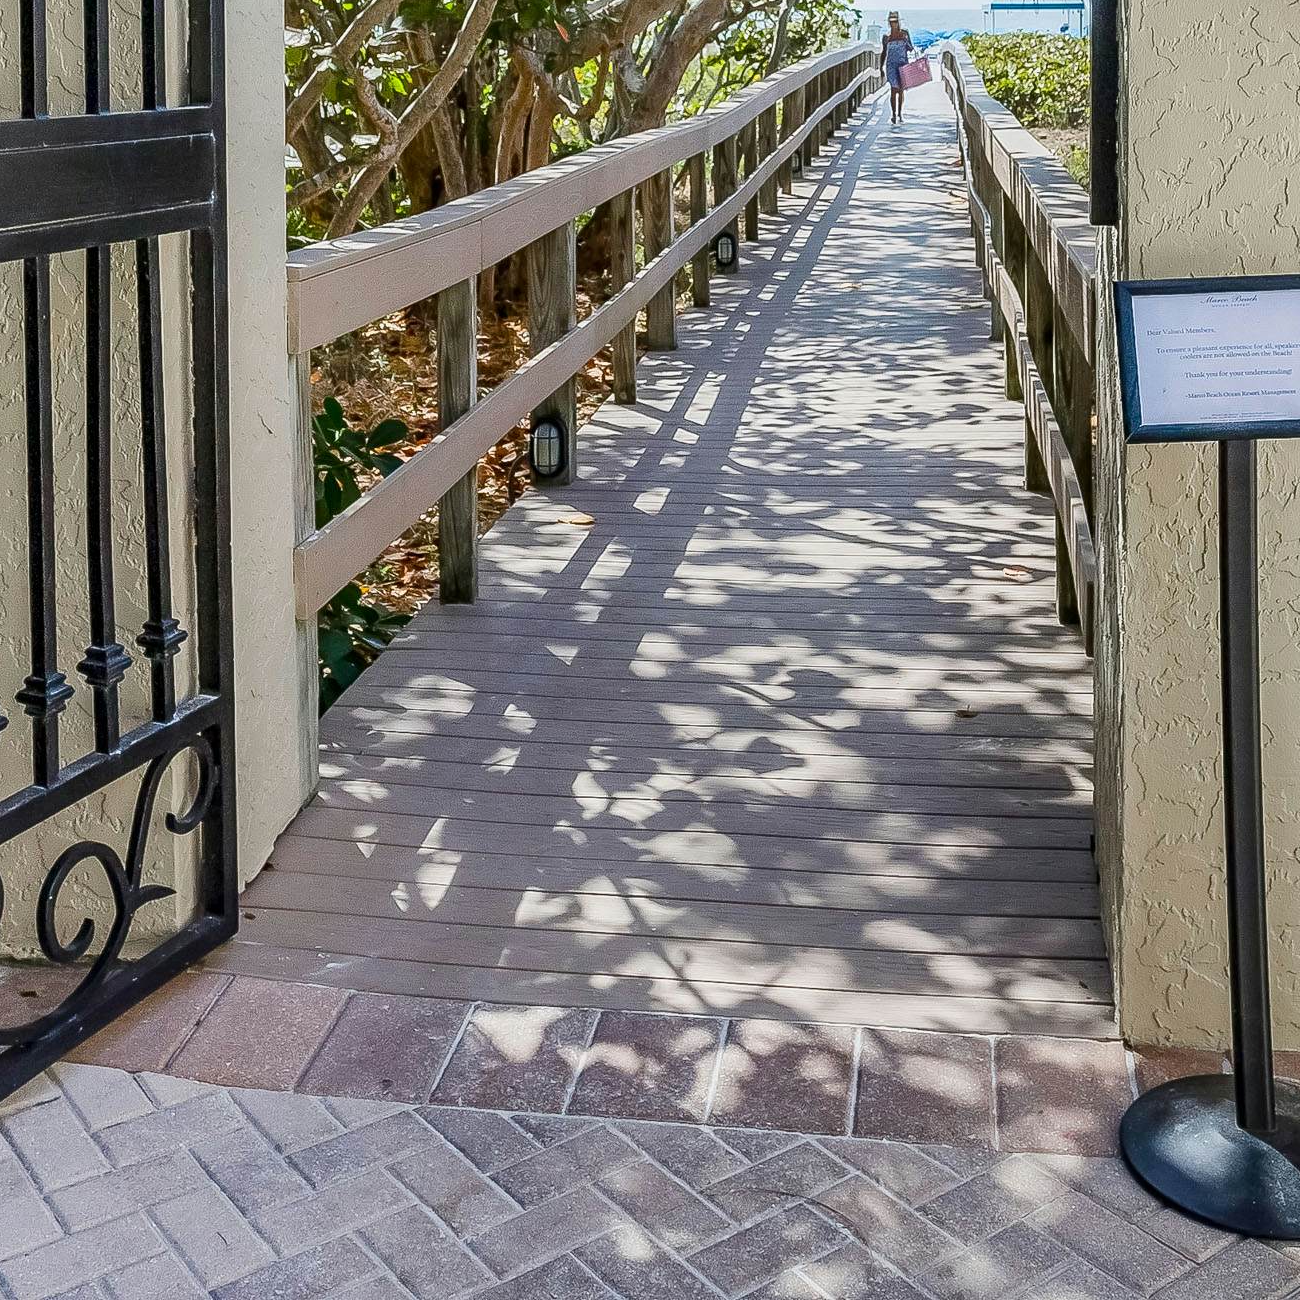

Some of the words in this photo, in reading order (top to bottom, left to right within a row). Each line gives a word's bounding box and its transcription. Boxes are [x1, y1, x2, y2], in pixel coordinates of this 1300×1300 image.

[1200, 295, 1227, 304] Marco
[1232, 294, 1257, 303] Beach
[1192, 345, 1217, 353] pleasant
[1219, 344, 1252, 352] experience
[1206, 371, 1218, 379] you
